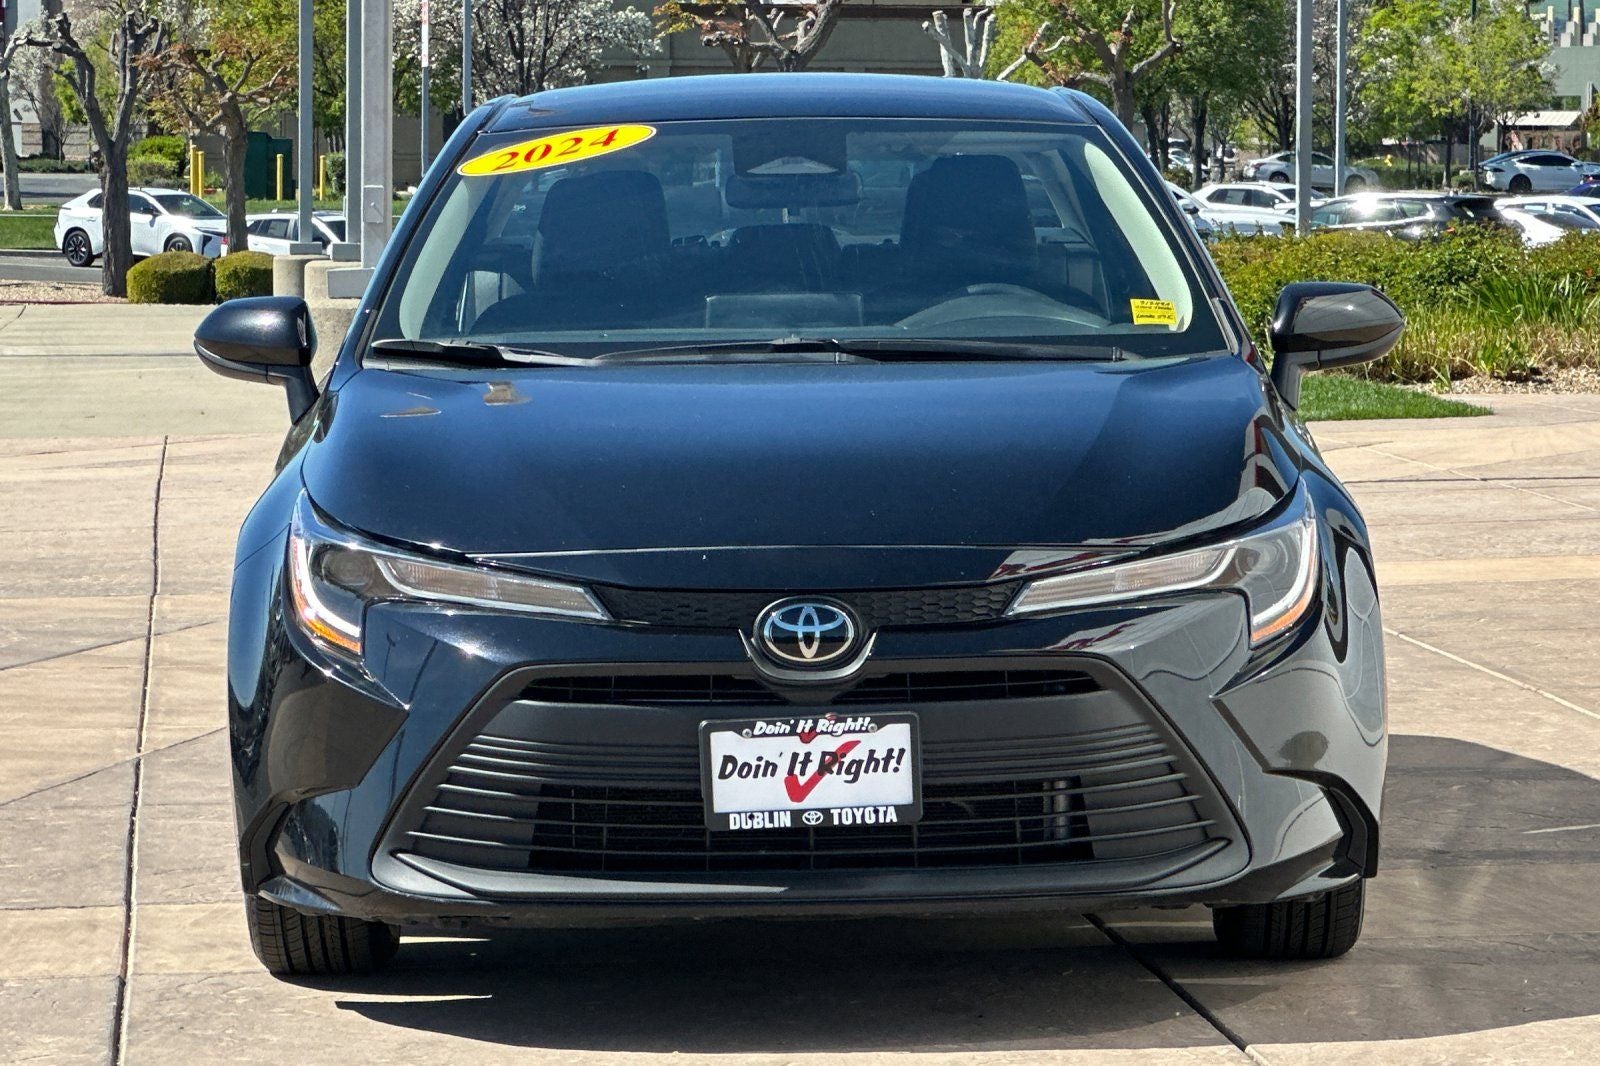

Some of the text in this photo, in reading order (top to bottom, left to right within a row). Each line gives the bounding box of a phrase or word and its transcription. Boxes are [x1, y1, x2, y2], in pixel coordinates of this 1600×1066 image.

[491, 129, 619, 172] 2024
[753, 717, 871, 736] Doin' It Right!
[718, 748, 906, 784] Doin' It Right!
[729, 806, 898, 830] DUBLIN TOYOTA
